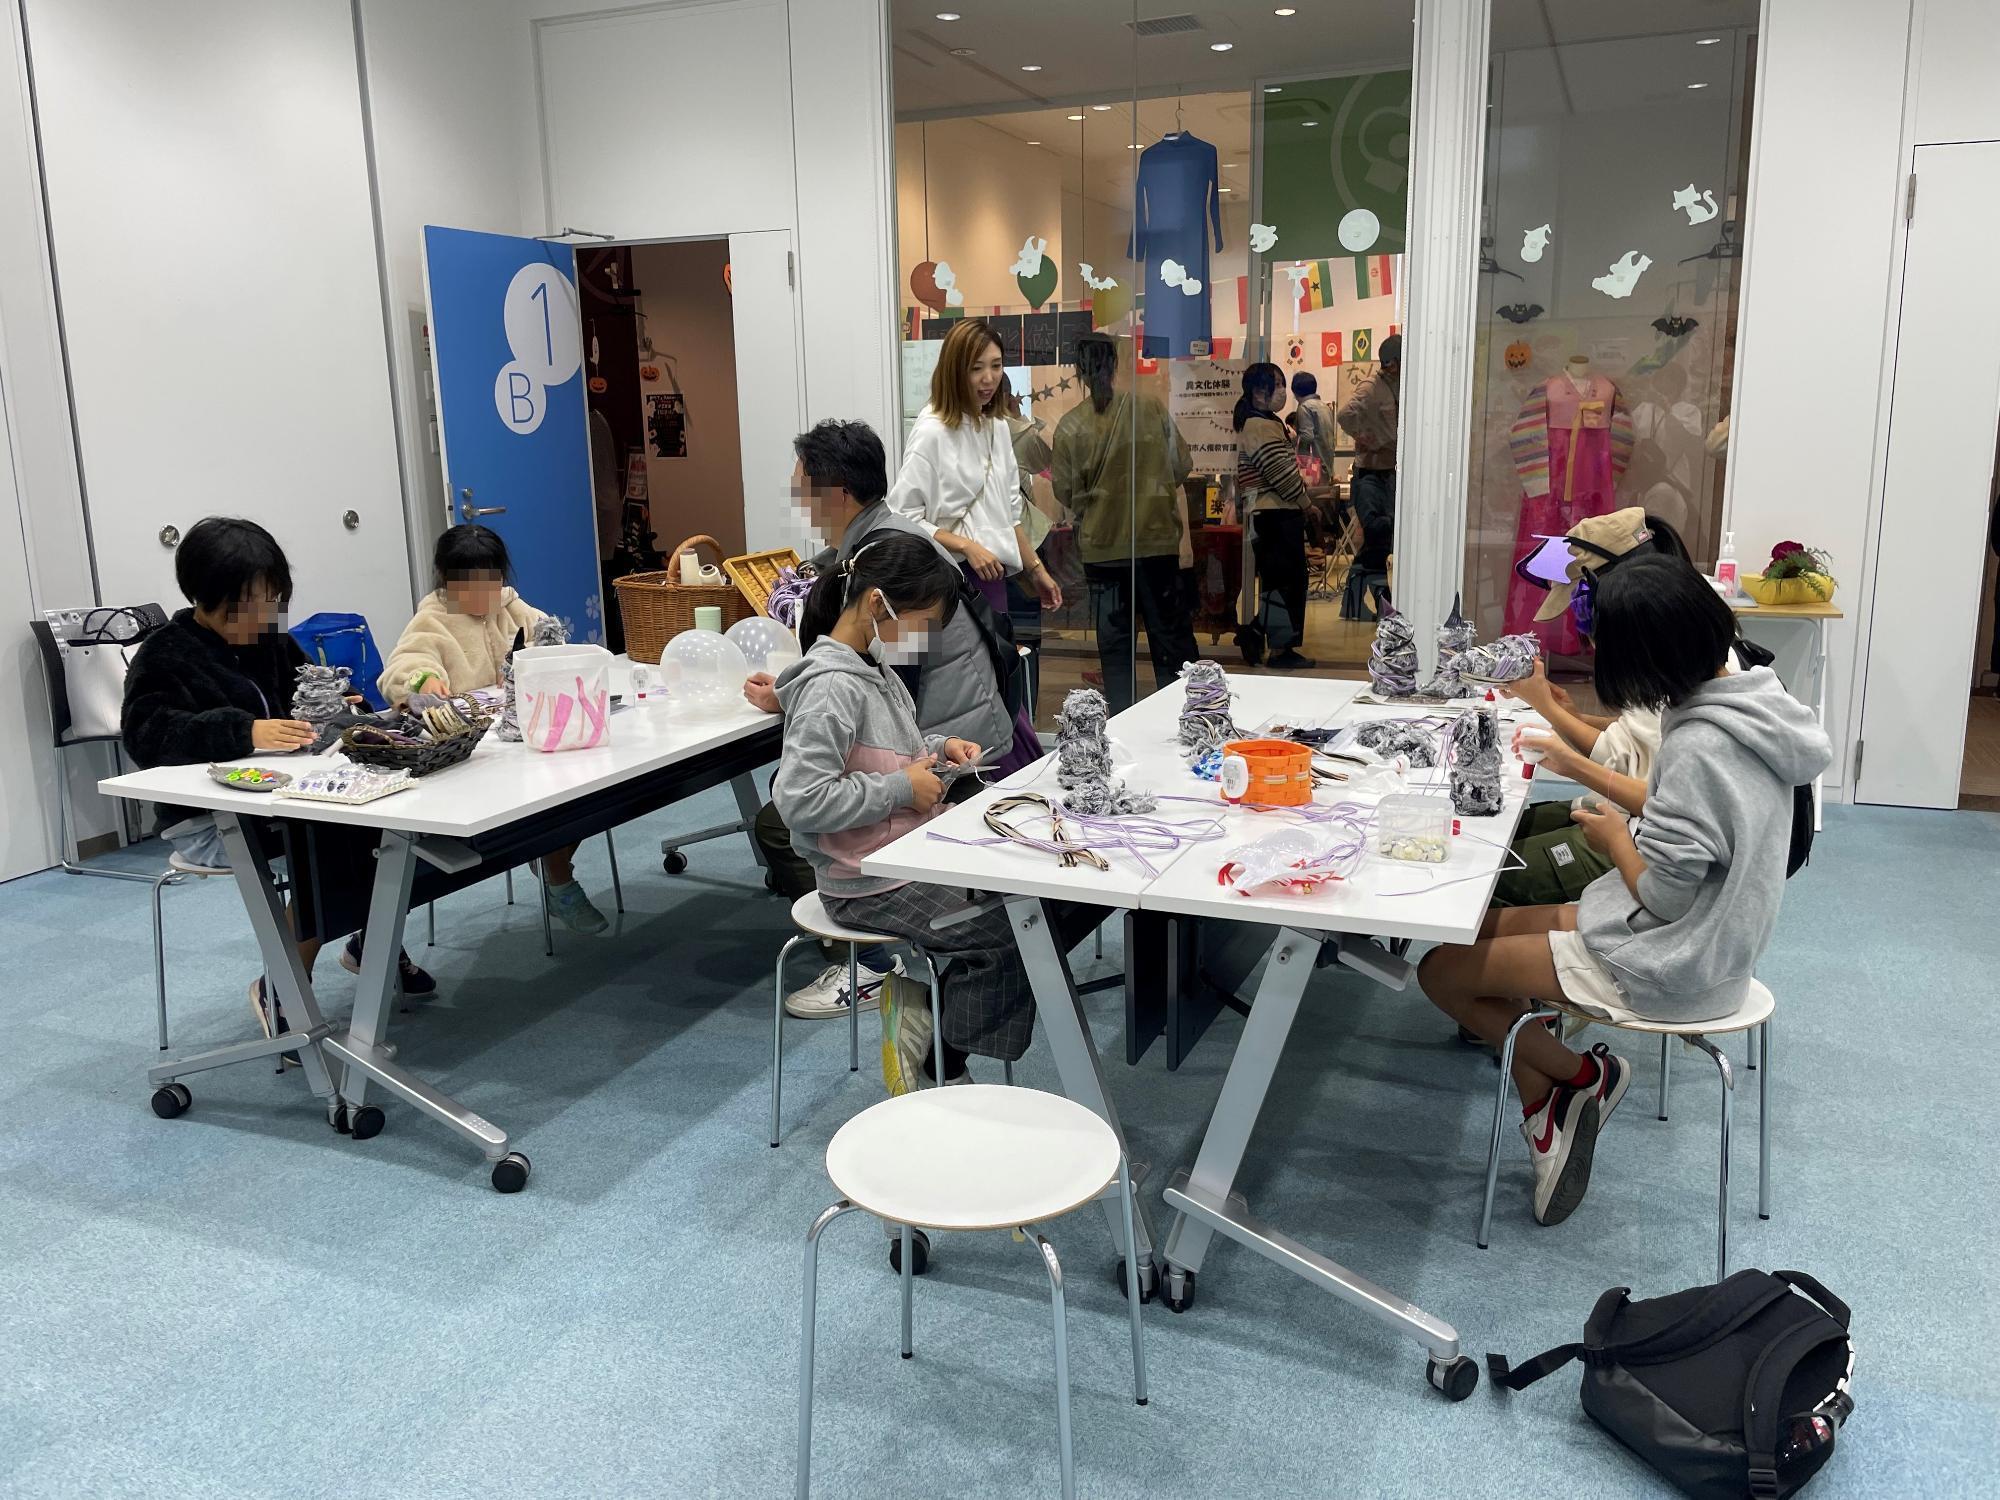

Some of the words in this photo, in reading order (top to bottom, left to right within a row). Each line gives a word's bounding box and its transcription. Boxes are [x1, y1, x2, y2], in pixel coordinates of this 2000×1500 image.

[530, 282, 553, 366] 1
[508, 372, 535, 424] B
[1185, 379, 1230, 390] 異文化体験
